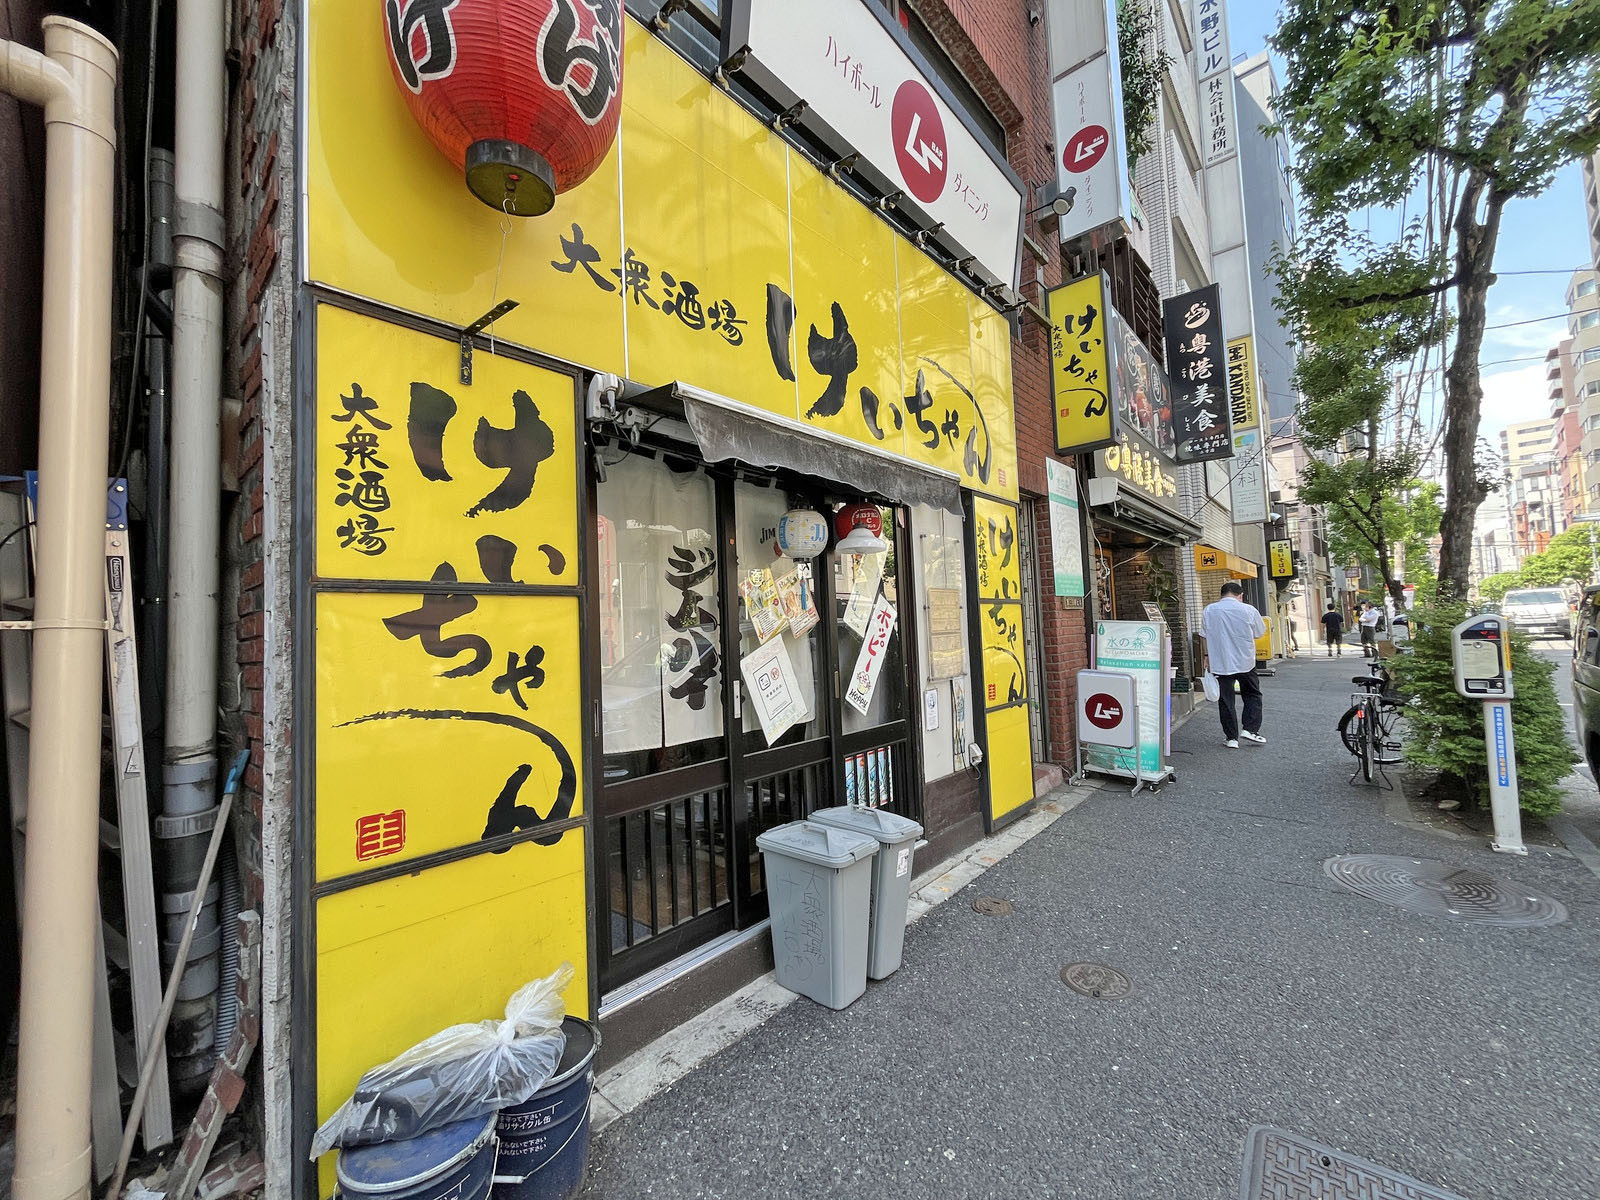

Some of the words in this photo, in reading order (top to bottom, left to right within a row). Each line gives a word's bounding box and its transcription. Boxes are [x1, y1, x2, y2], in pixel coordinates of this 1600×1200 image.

[824, 36, 882, 108] ハイボール
[1077, 81, 1087, 123] ハイボール
[1208, 78, 1227, 153] 林会計事務所
[954, 173, 991, 220] ダイニング
[551, 222, 748, 346] 大衆酒場
[766, 282, 991, 485] けいちゃん
[1057, 304, 1108, 418] けいちゃん
[1229, 364, 1252, 425] KANDAHAR
[331, 383, 394, 556] 大衆酒場
[760, 527, 776, 545] JIM
[977, 521, 989, 588] 大衆酒場
[331, 381, 577, 854] けいちゃん
[866, 607, 892, 673] ホッピー
[983, 515, 1025, 709] けいちゃん
[1107, 636, 1145, 648] 水の森
